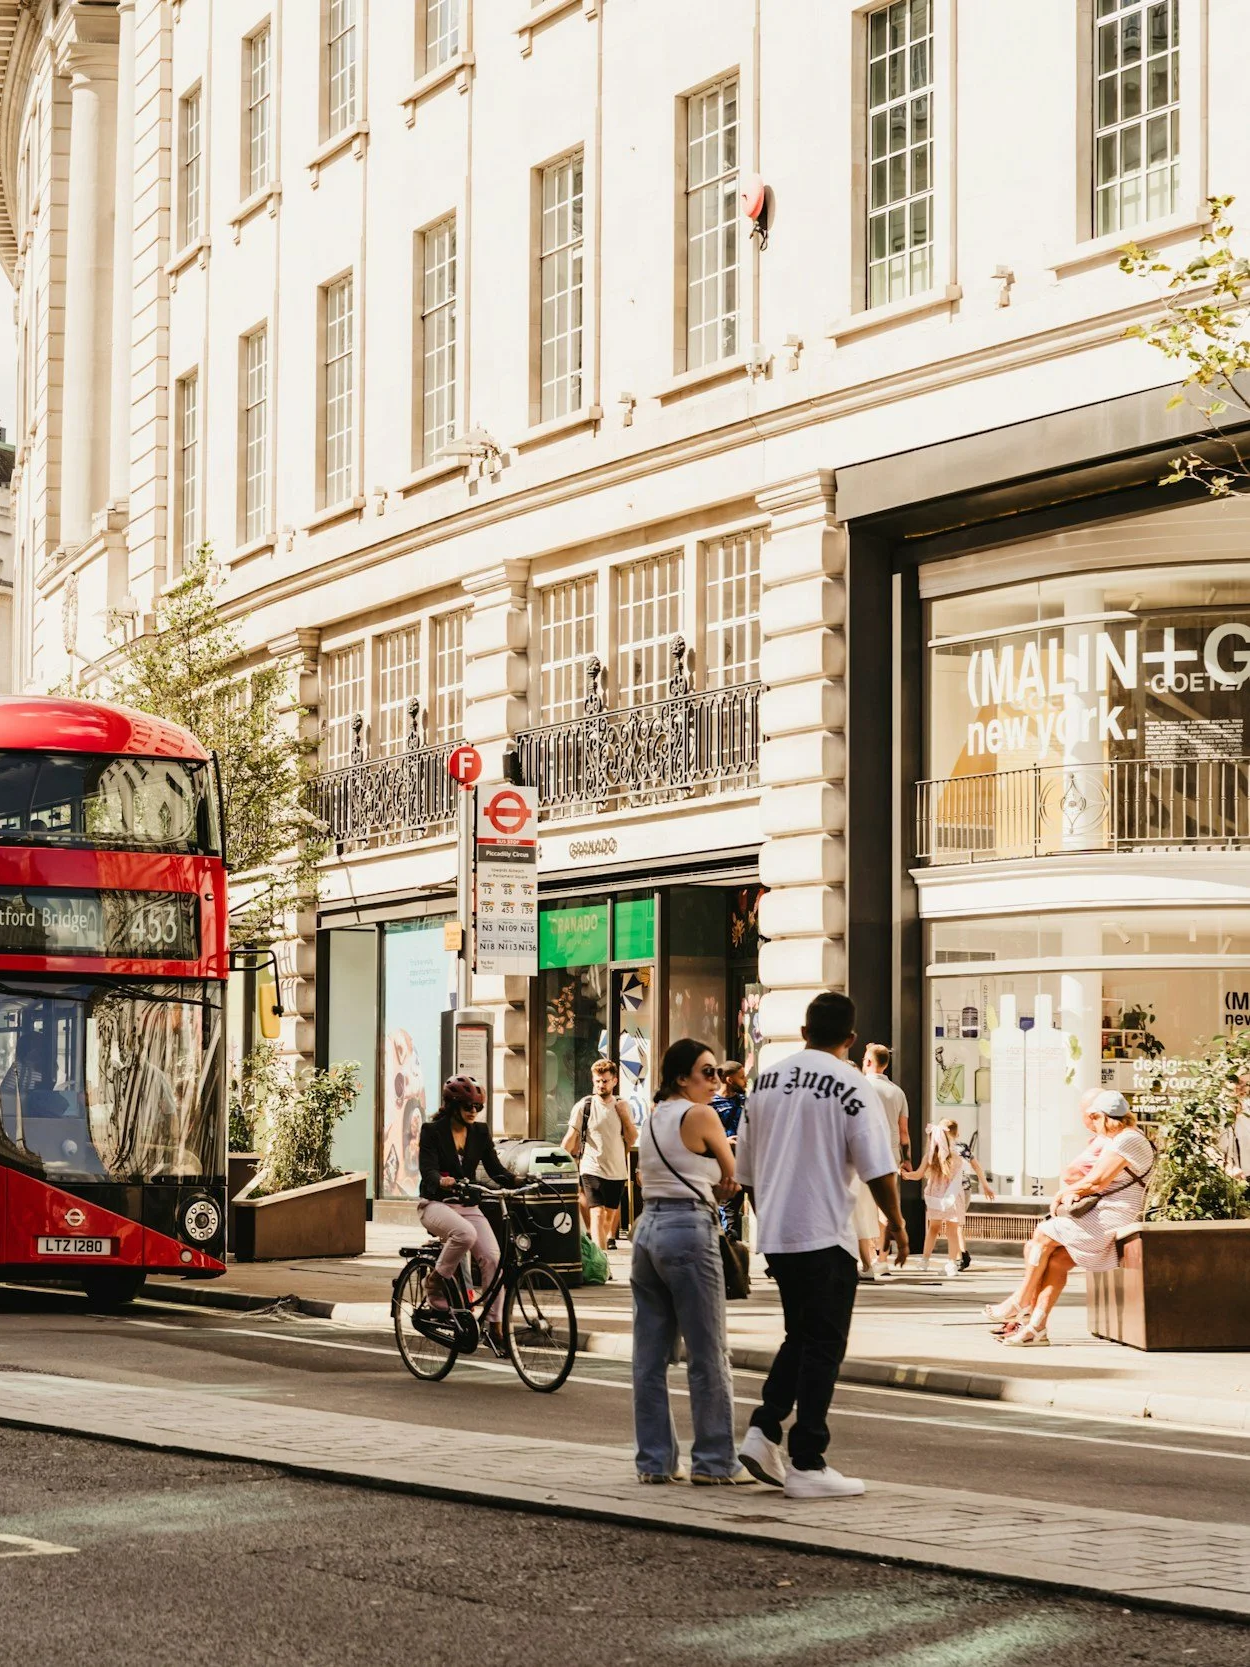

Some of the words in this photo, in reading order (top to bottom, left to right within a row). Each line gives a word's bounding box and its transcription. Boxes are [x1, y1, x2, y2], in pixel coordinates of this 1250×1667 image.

[967, 715, 1029, 757] new
[459, 752, 474, 778] F
[485, 850, 511, 858] Piccadilly
[42, 906, 88, 933] Bridge
[130, 906, 178, 943] 453
[498, 943, 517, 951] N113
[783, 1066, 866, 1118] Angels
[46, 1239, 70, 1251] LTZ
[74, 1239, 102, 1252] 1280
